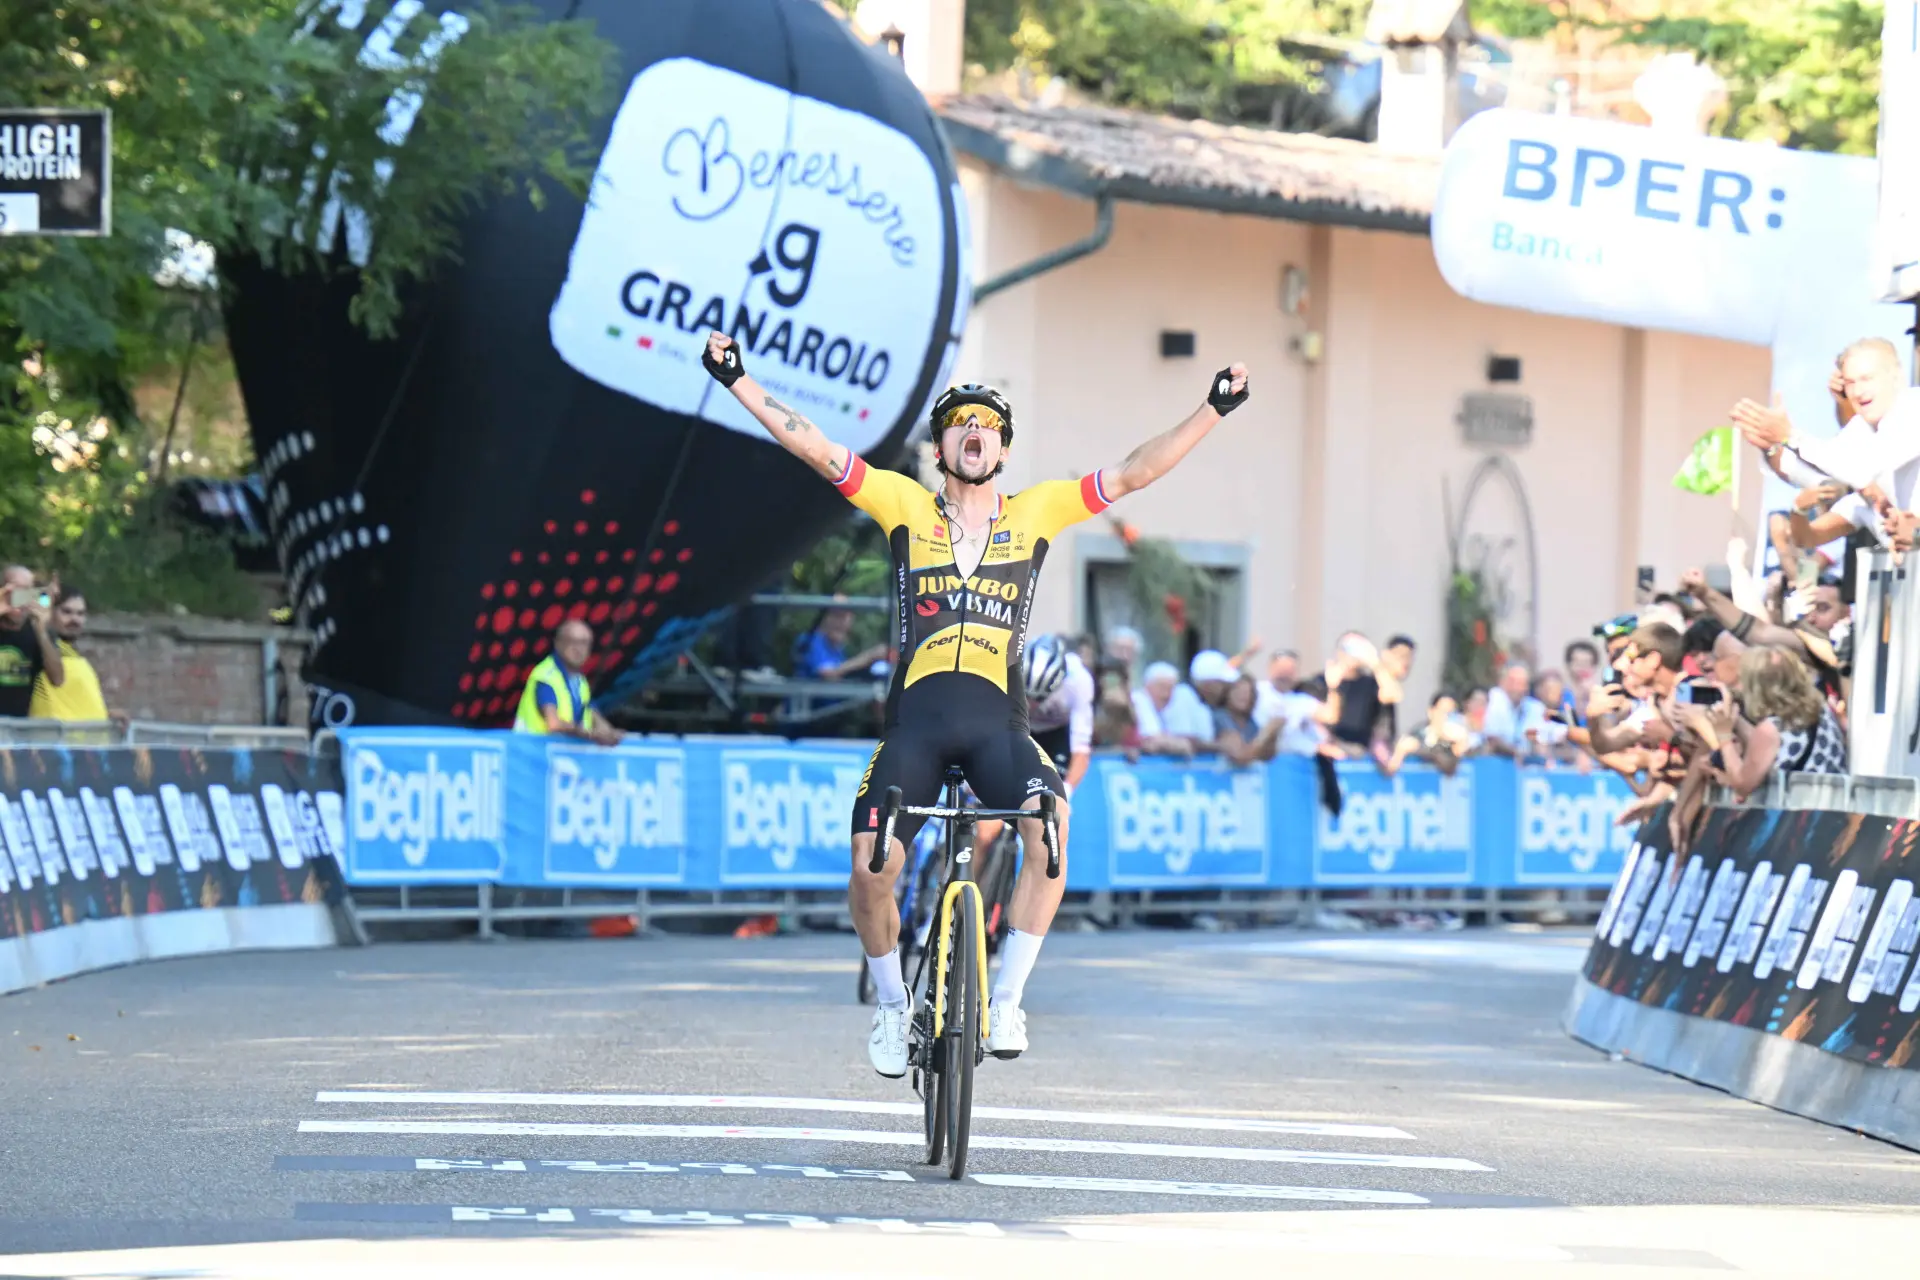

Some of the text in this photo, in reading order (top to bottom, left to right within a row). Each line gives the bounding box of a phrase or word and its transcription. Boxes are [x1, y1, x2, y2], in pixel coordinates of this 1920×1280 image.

[0, 154, 81, 180] ROTEIN
[662, 116, 917, 267] Benessere
[1491, 222, 1604, 264] Banca
[620, 271, 891, 391] GRANAROLO
[916, 575, 1019, 601] JUMBO
[947, 593, 1012, 625] VISMA
[1016, 577, 1035, 657] BETCITY.NL
[354, 749, 500, 866] Beghelli
[552, 756, 682, 870] Beghelli
[1109, 772, 1264, 873] Beghelli
